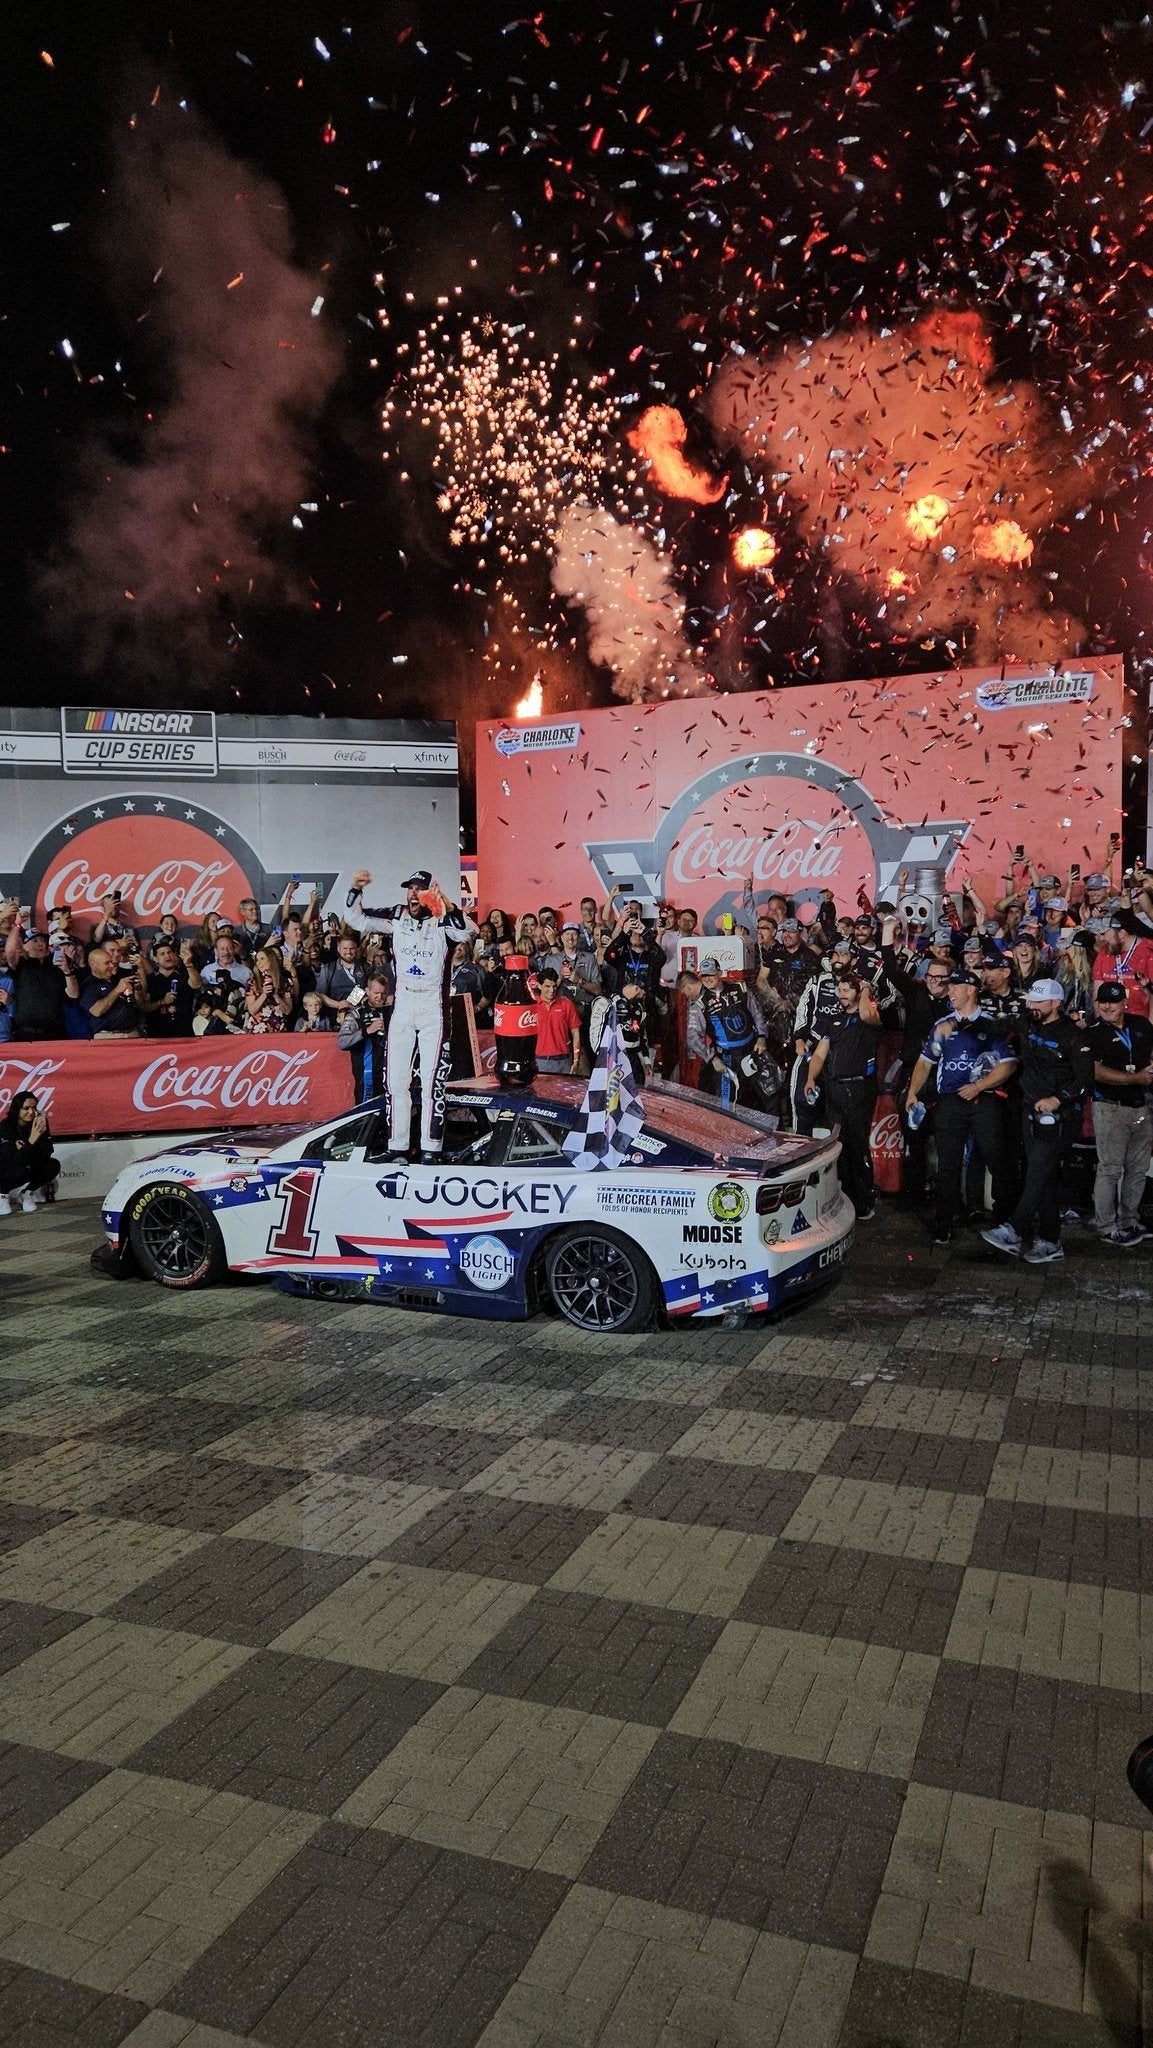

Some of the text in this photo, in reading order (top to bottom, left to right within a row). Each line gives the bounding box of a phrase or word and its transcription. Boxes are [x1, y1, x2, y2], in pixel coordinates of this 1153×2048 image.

[112, 712, 193, 733] NASCAR
[523, 727, 576, 743] CHARLOTTE
[85, 741, 196, 761] CUP SERIES
[258, 751, 287, 760] BUSCH
[414, 751, 449, 764] xfinity
[673, 818, 852, 883] Coca-Cola
[44, 859, 234, 916] Coca-Cola
[401, 948, 434, 958] JOCKEY
[133, 1049, 320, 1113] Coca-Cola
[434, 1059, 453, 1125] JOCKEY
[525, 1106, 558, 1118] SIEMENS
[132, 1187, 187, 1221] GOODYEAR
[414, 1176, 577, 1214] JOCKEY
[597, 1192, 696, 1209] THE MCCREA FAMILY
[267, 1167, 325, 1257] 1
[630, 1206, 651, 1214] HONOR
[653, 1208, 688, 1216] RECIPIENTS
[683, 1225, 742, 1244] MOOSE
[461, 1251, 513, 1274] BUSCH
[680, 1253, 747, 1270] Kubota
[472, 1270, 503, 1281] LIGHT
